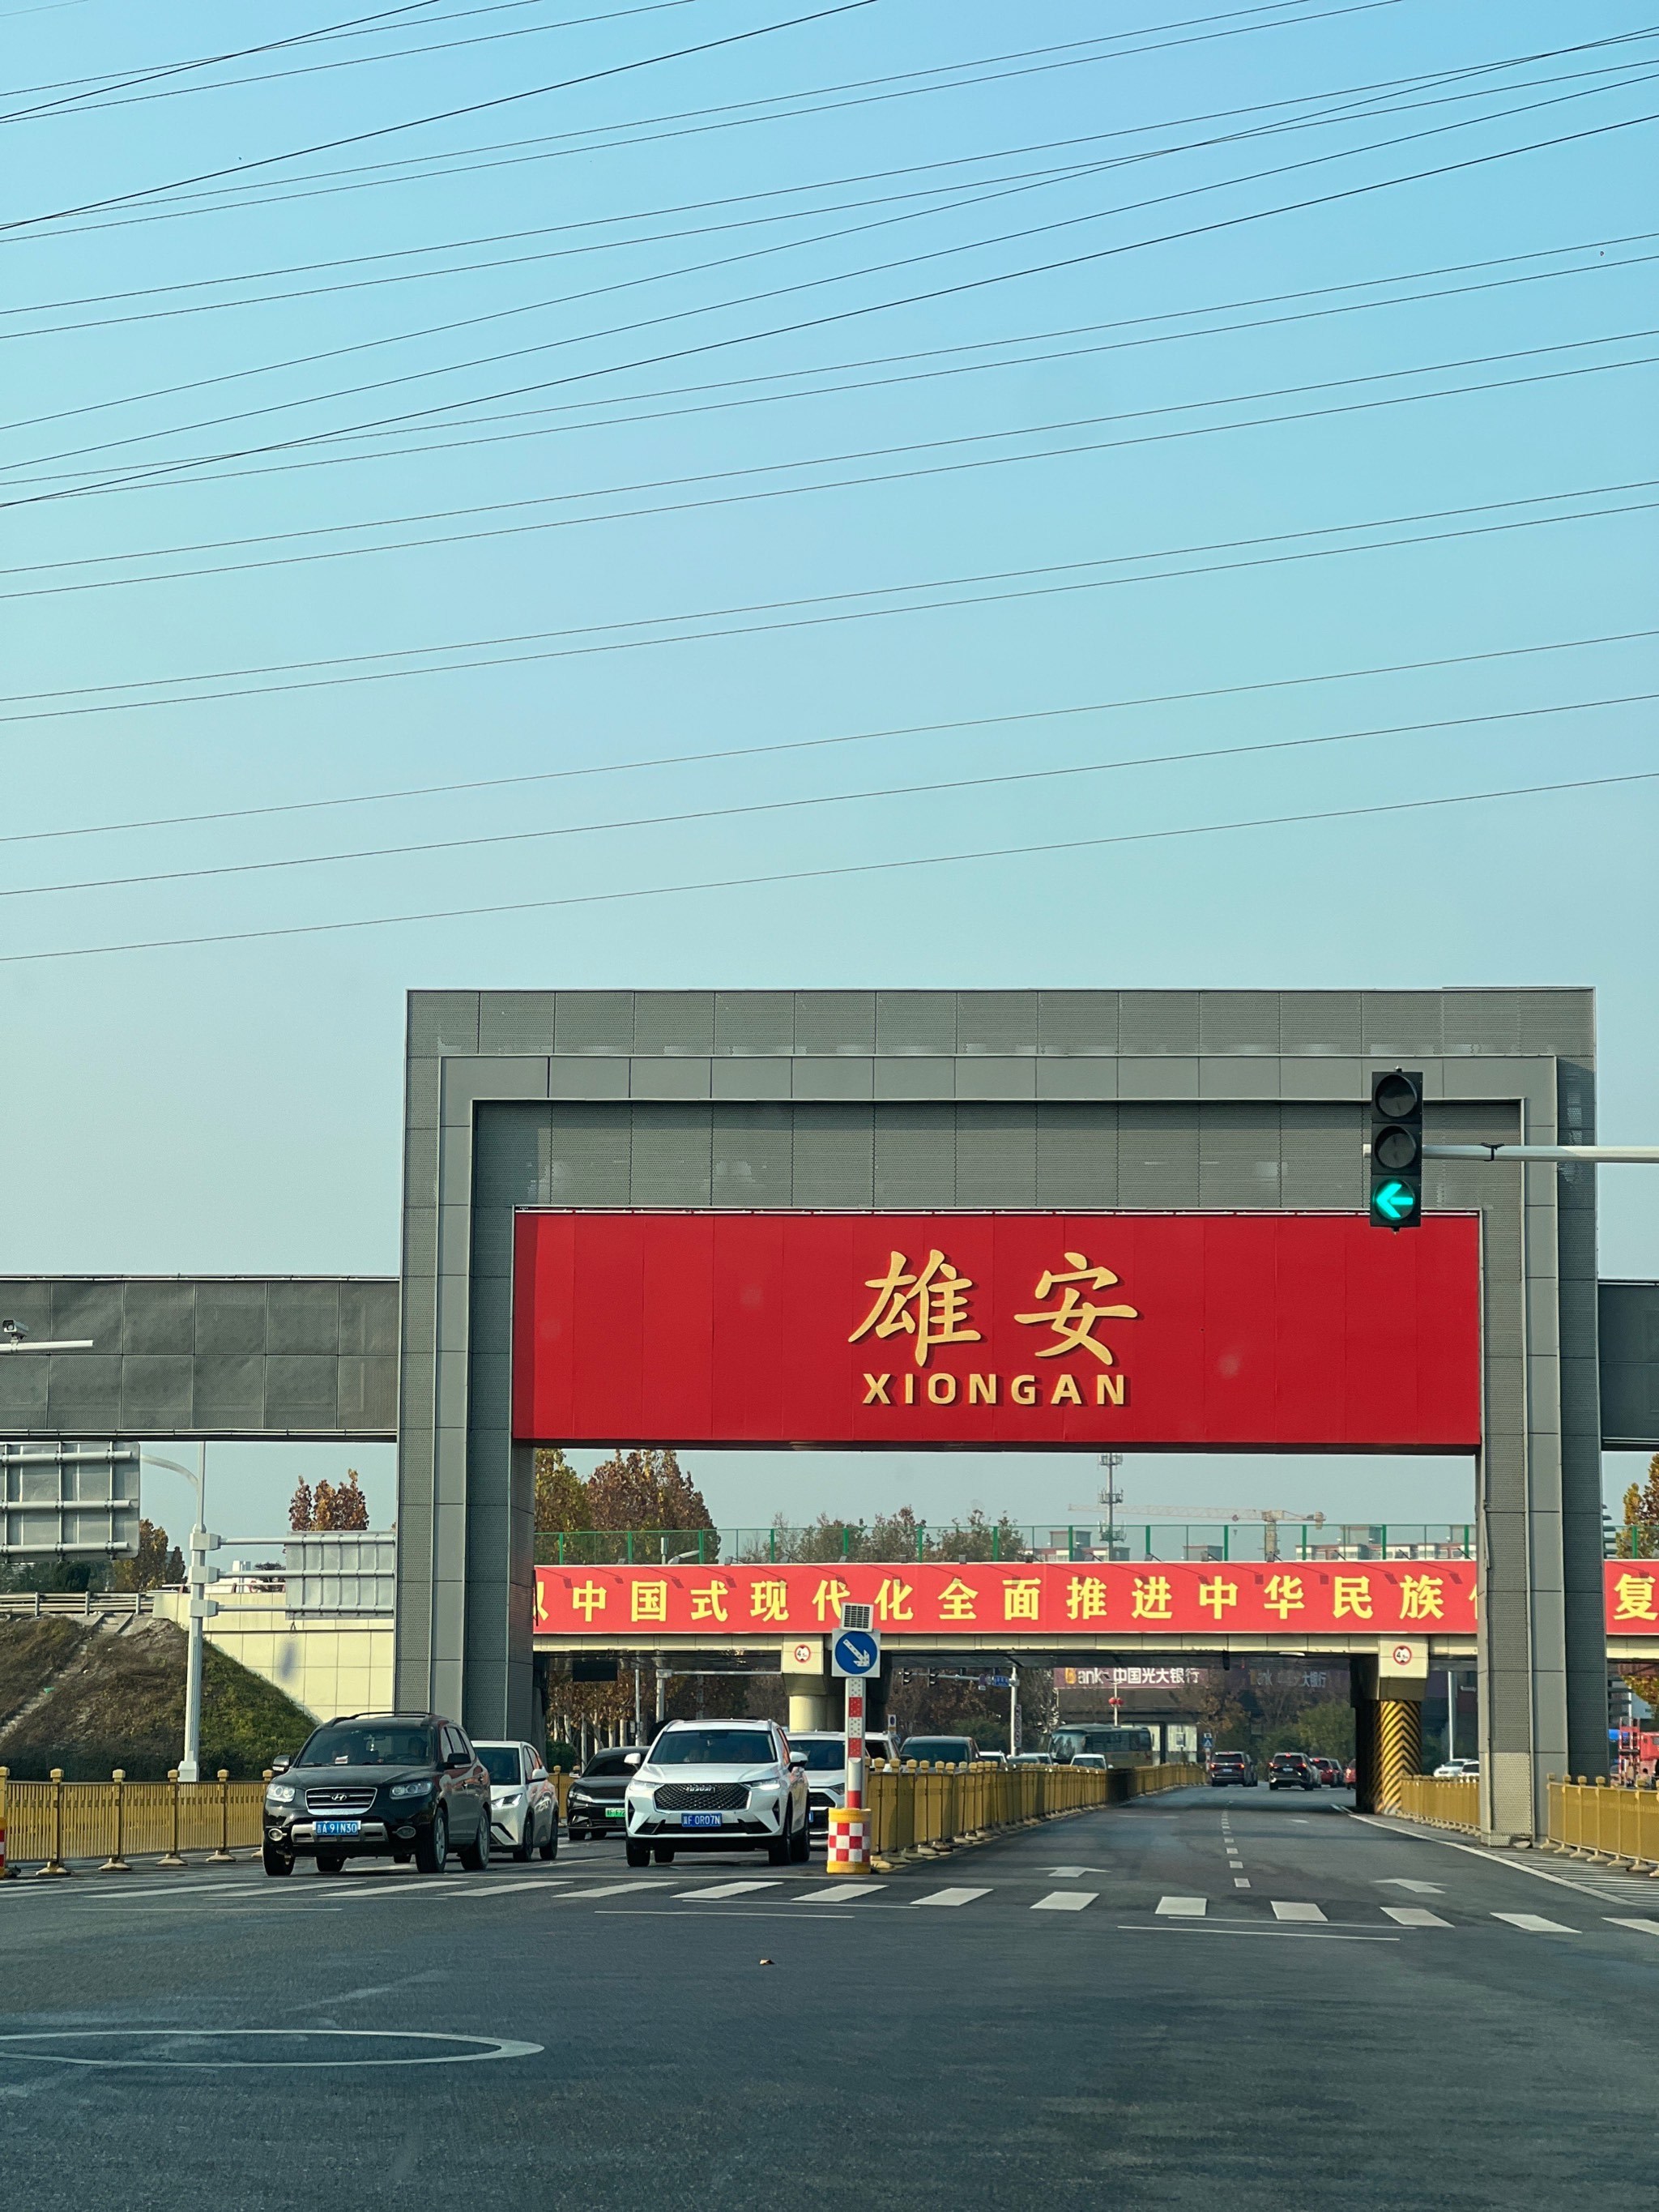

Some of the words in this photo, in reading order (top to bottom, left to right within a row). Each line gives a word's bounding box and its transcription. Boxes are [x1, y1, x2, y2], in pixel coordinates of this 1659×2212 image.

[848, 1249, 1138, 1367] 雄安
[863, 1373, 1125, 1405] XIONGAN
[1113, 1668, 1201, 1684] 中国光大银行
